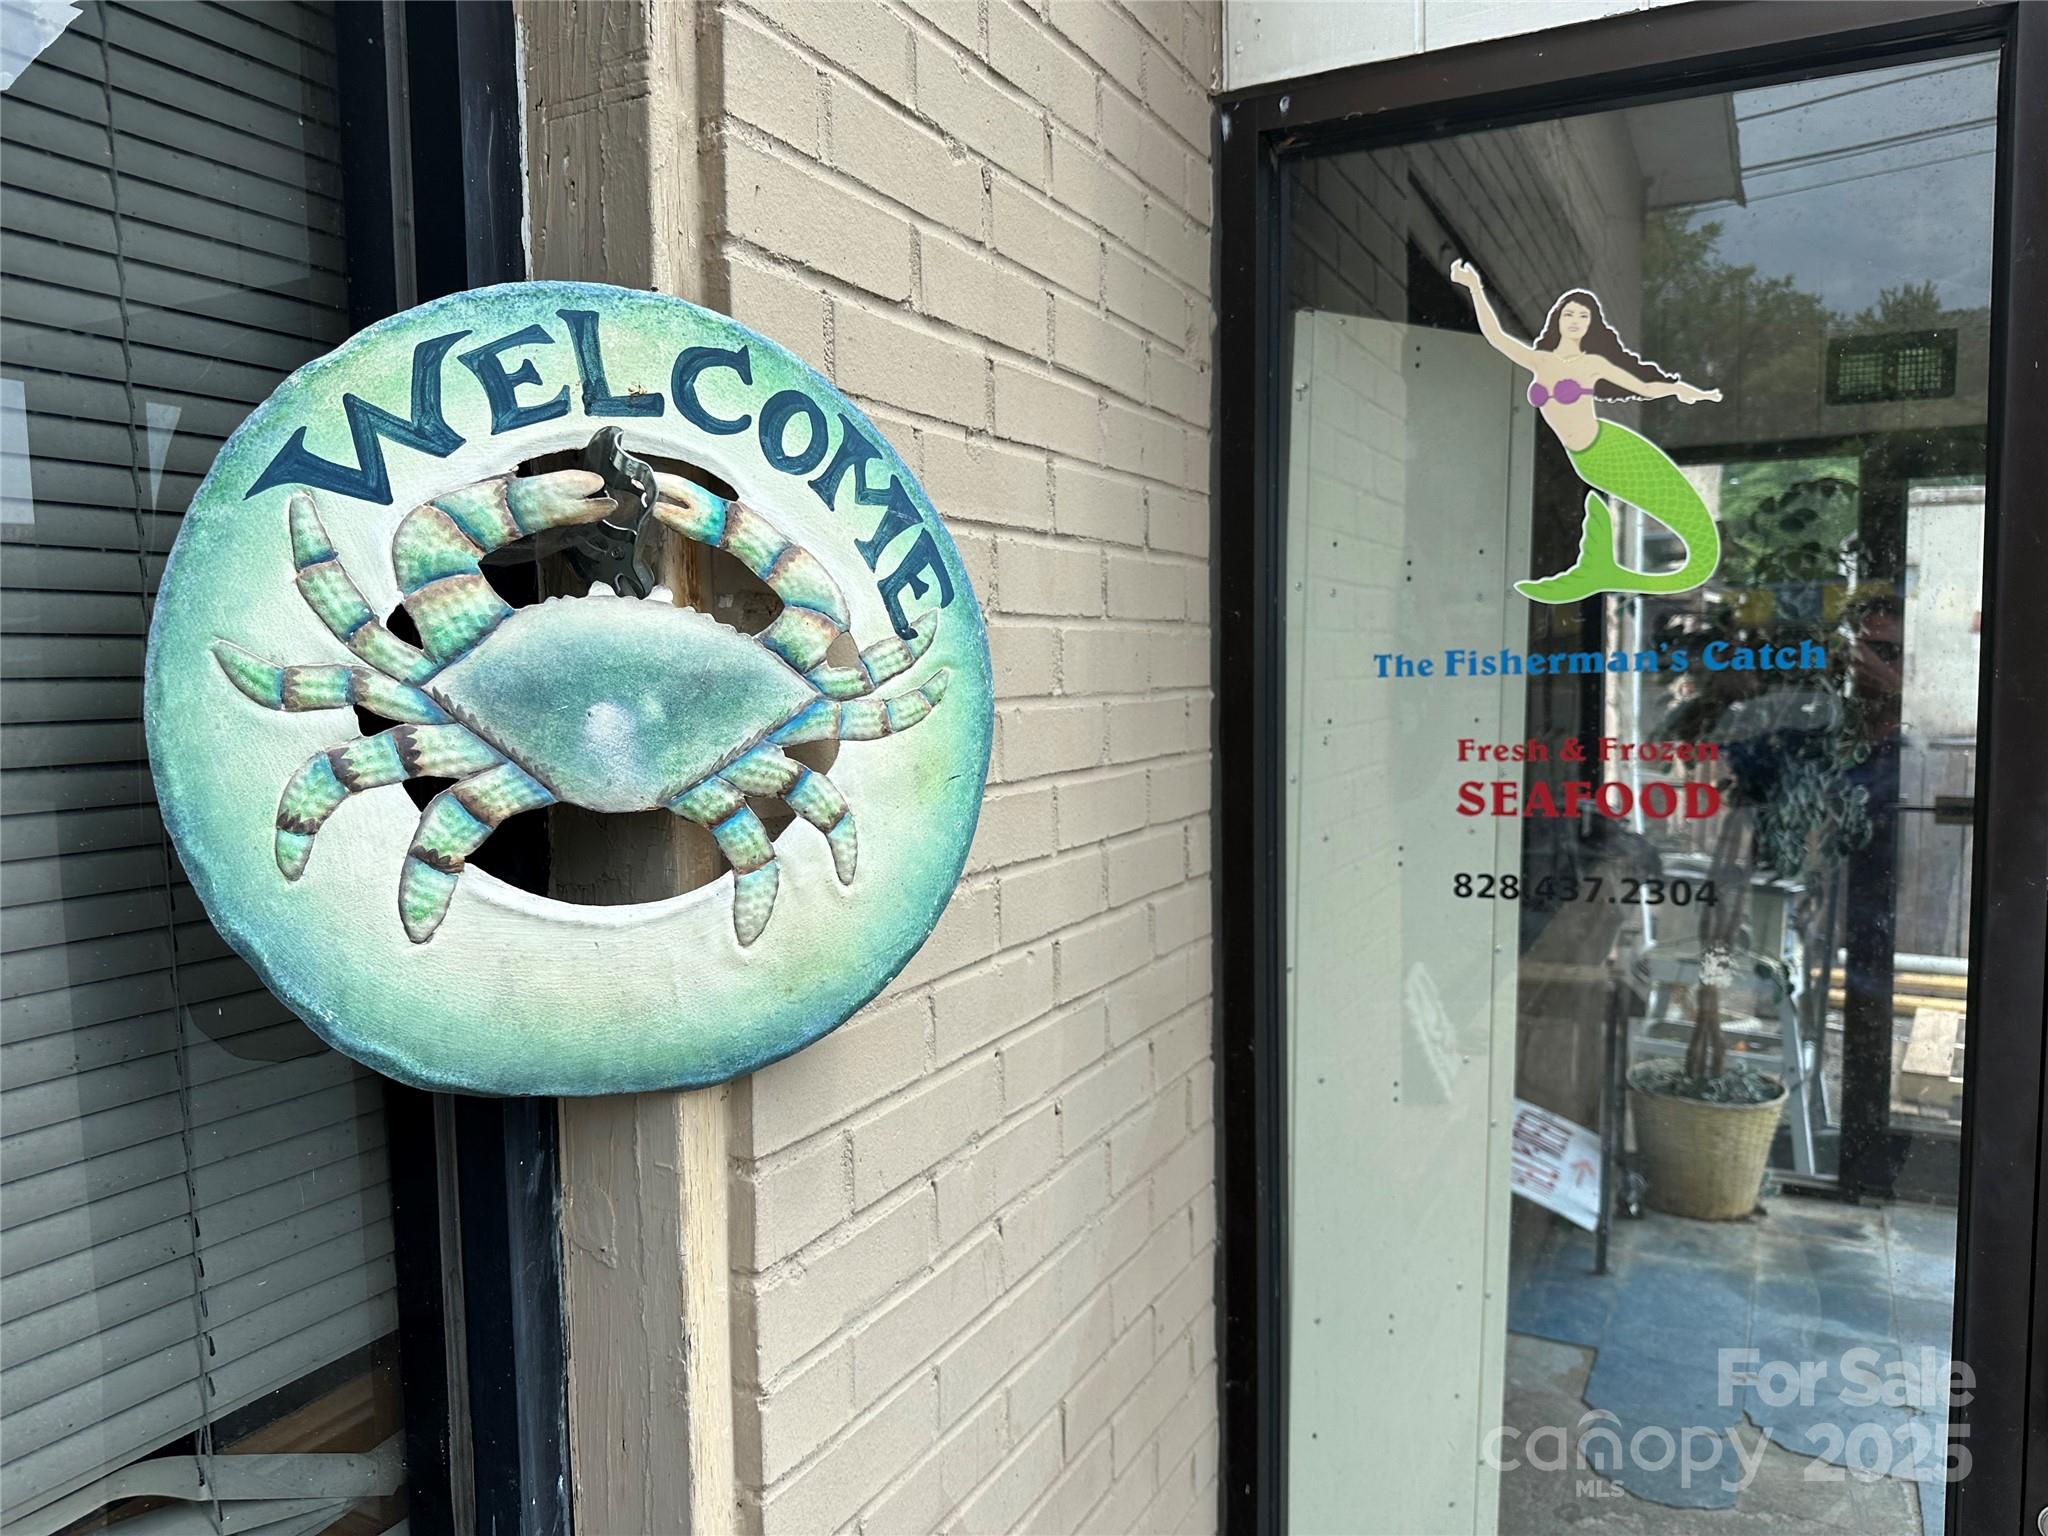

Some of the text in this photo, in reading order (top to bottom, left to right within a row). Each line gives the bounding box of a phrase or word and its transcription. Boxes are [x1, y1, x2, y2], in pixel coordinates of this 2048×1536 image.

[245, 309, 956, 639] WELCOME
[1375, 640, 1827, 678] The Fisherman's Catch
[1457, 737, 1720, 763] Fresh & Frozen
[1456, 781, 1722, 820] SEAFOOD
[1454, 873, 1718, 907] 828.437.2304
